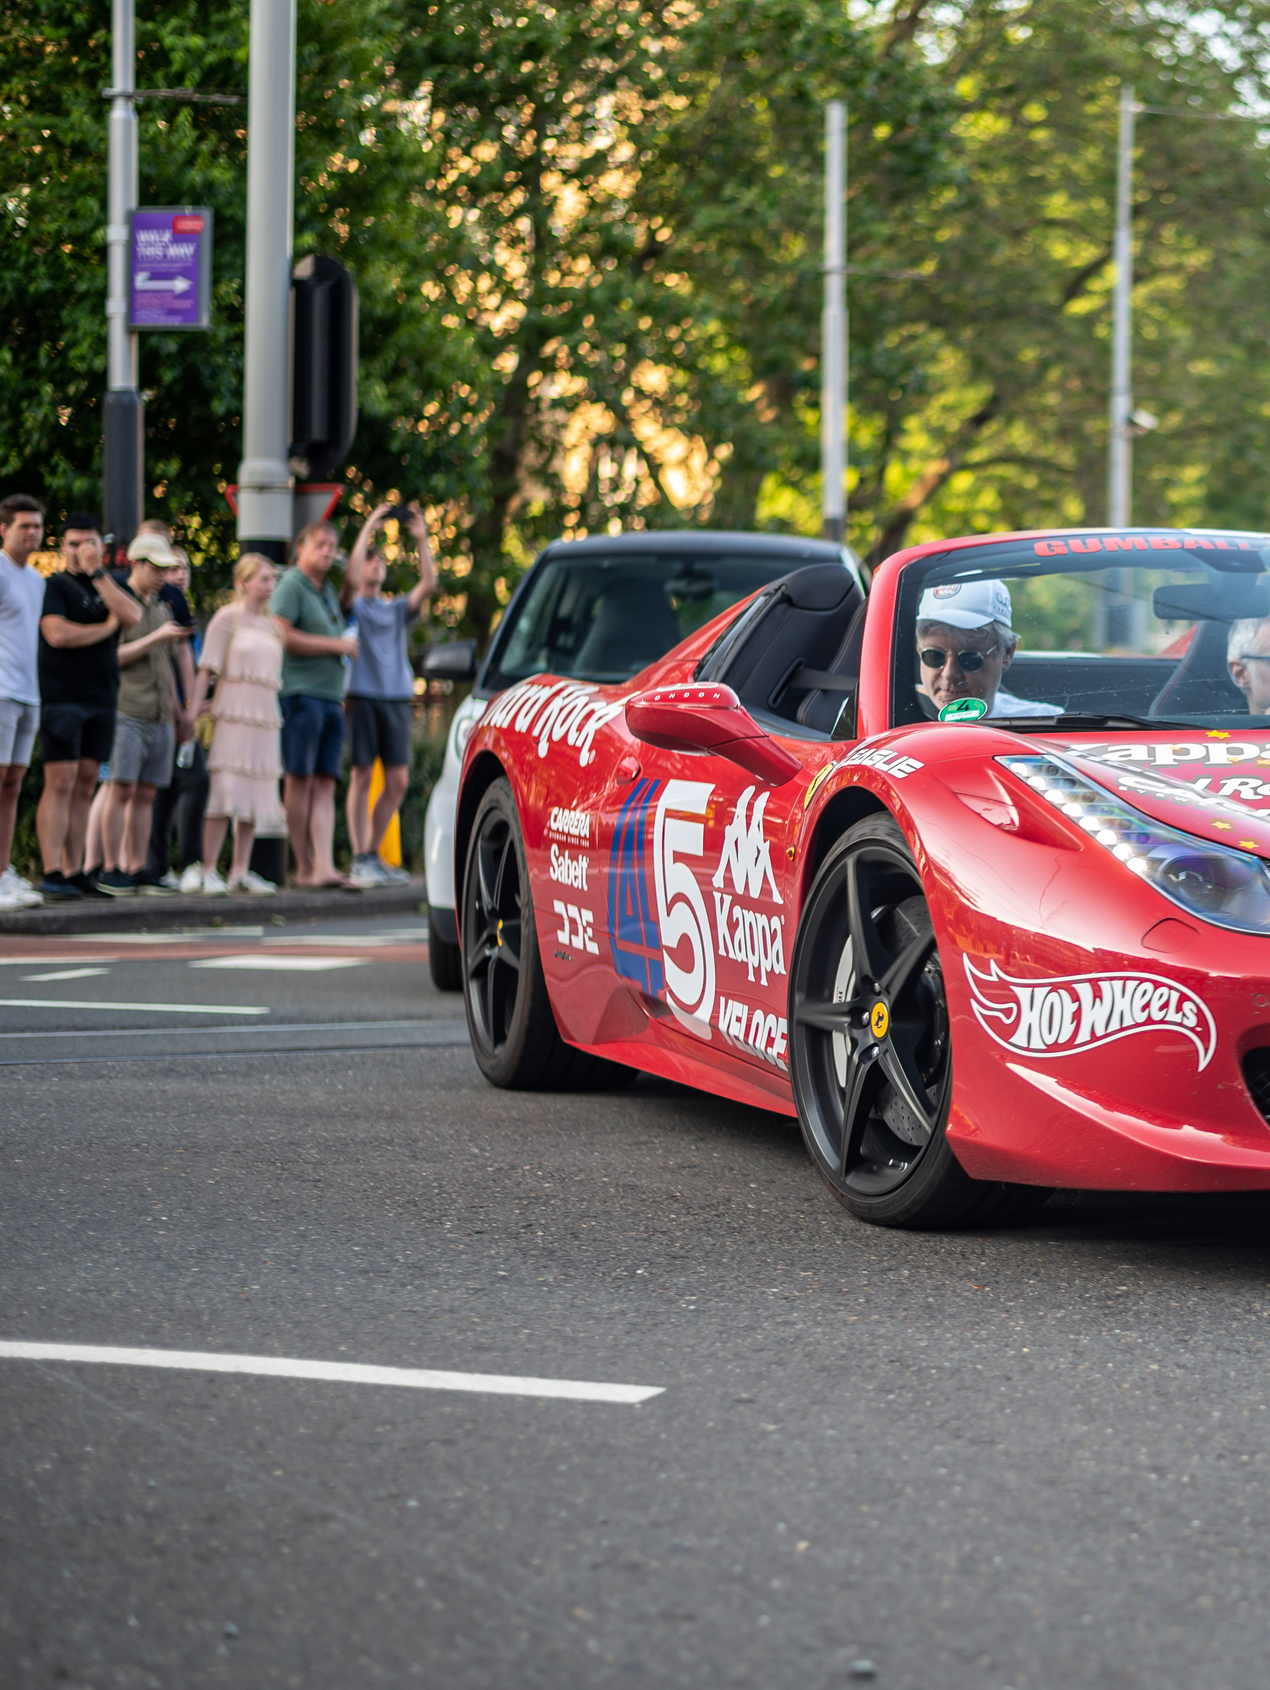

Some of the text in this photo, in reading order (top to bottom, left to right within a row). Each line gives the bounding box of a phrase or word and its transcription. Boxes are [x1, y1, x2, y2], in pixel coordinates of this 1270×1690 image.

[1033, 536, 1260, 557] GUMBALL
[532, 685, 642, 767] Rock
[550, 806, 591, 839] CARRERA
[550, 843, 588, 891] Sabelt
[713, 891, 786, 986] Kappa
[718, 996, 788, 1071] VELOCE
